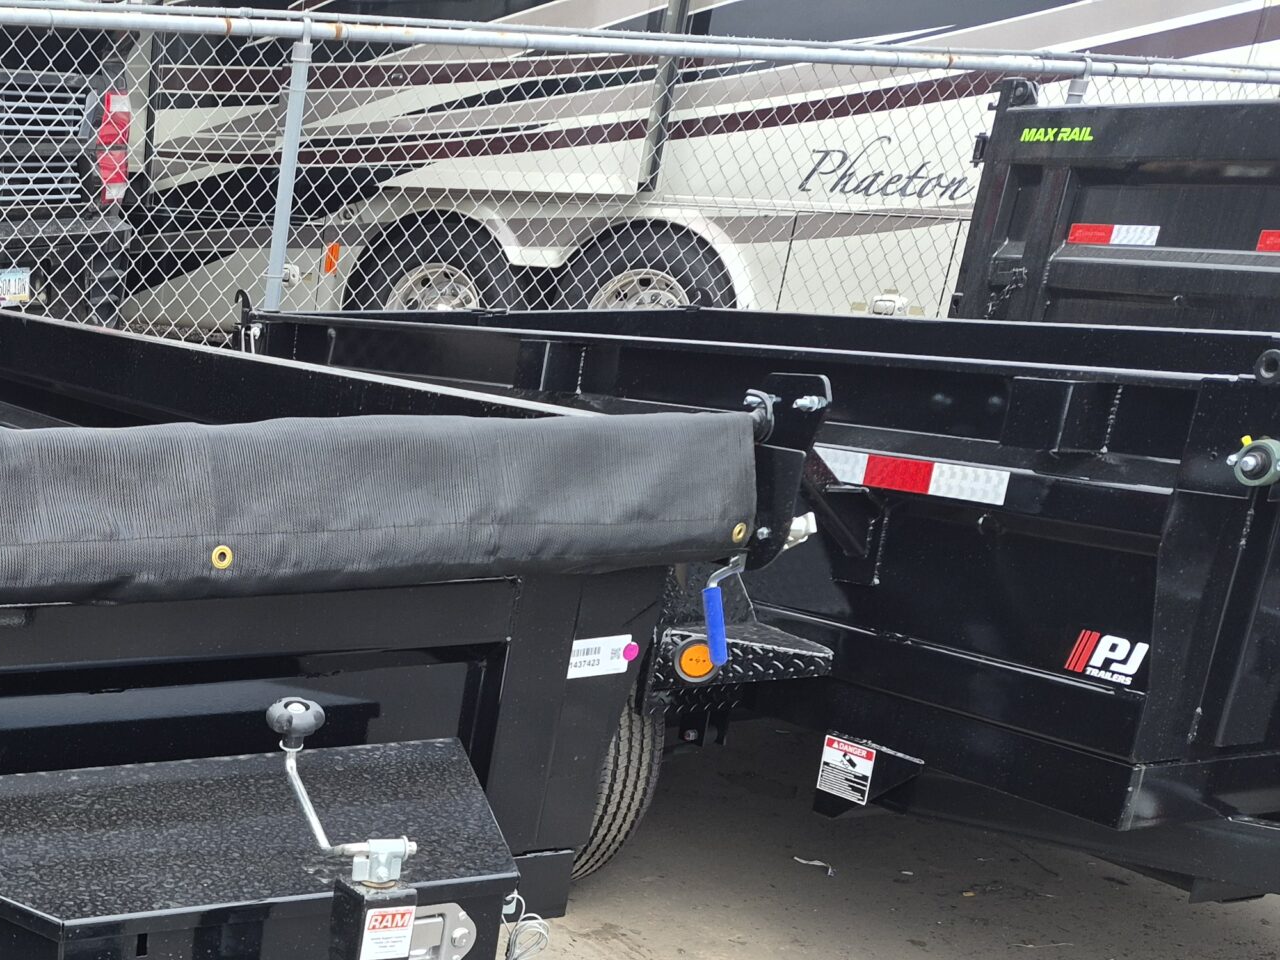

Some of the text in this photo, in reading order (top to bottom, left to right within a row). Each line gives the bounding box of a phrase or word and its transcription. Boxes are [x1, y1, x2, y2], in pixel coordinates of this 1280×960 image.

[1020, 127, 1094, 142] MAX RAIL
[798, 135, 975, 201] Phaeton
[1088, 634, 1150, 676] PJ
[1085, 666, 1133, 686] TRAILERS
[839, 742, 868, 758] DANGER
[369, 913, 412, 930] RAM
